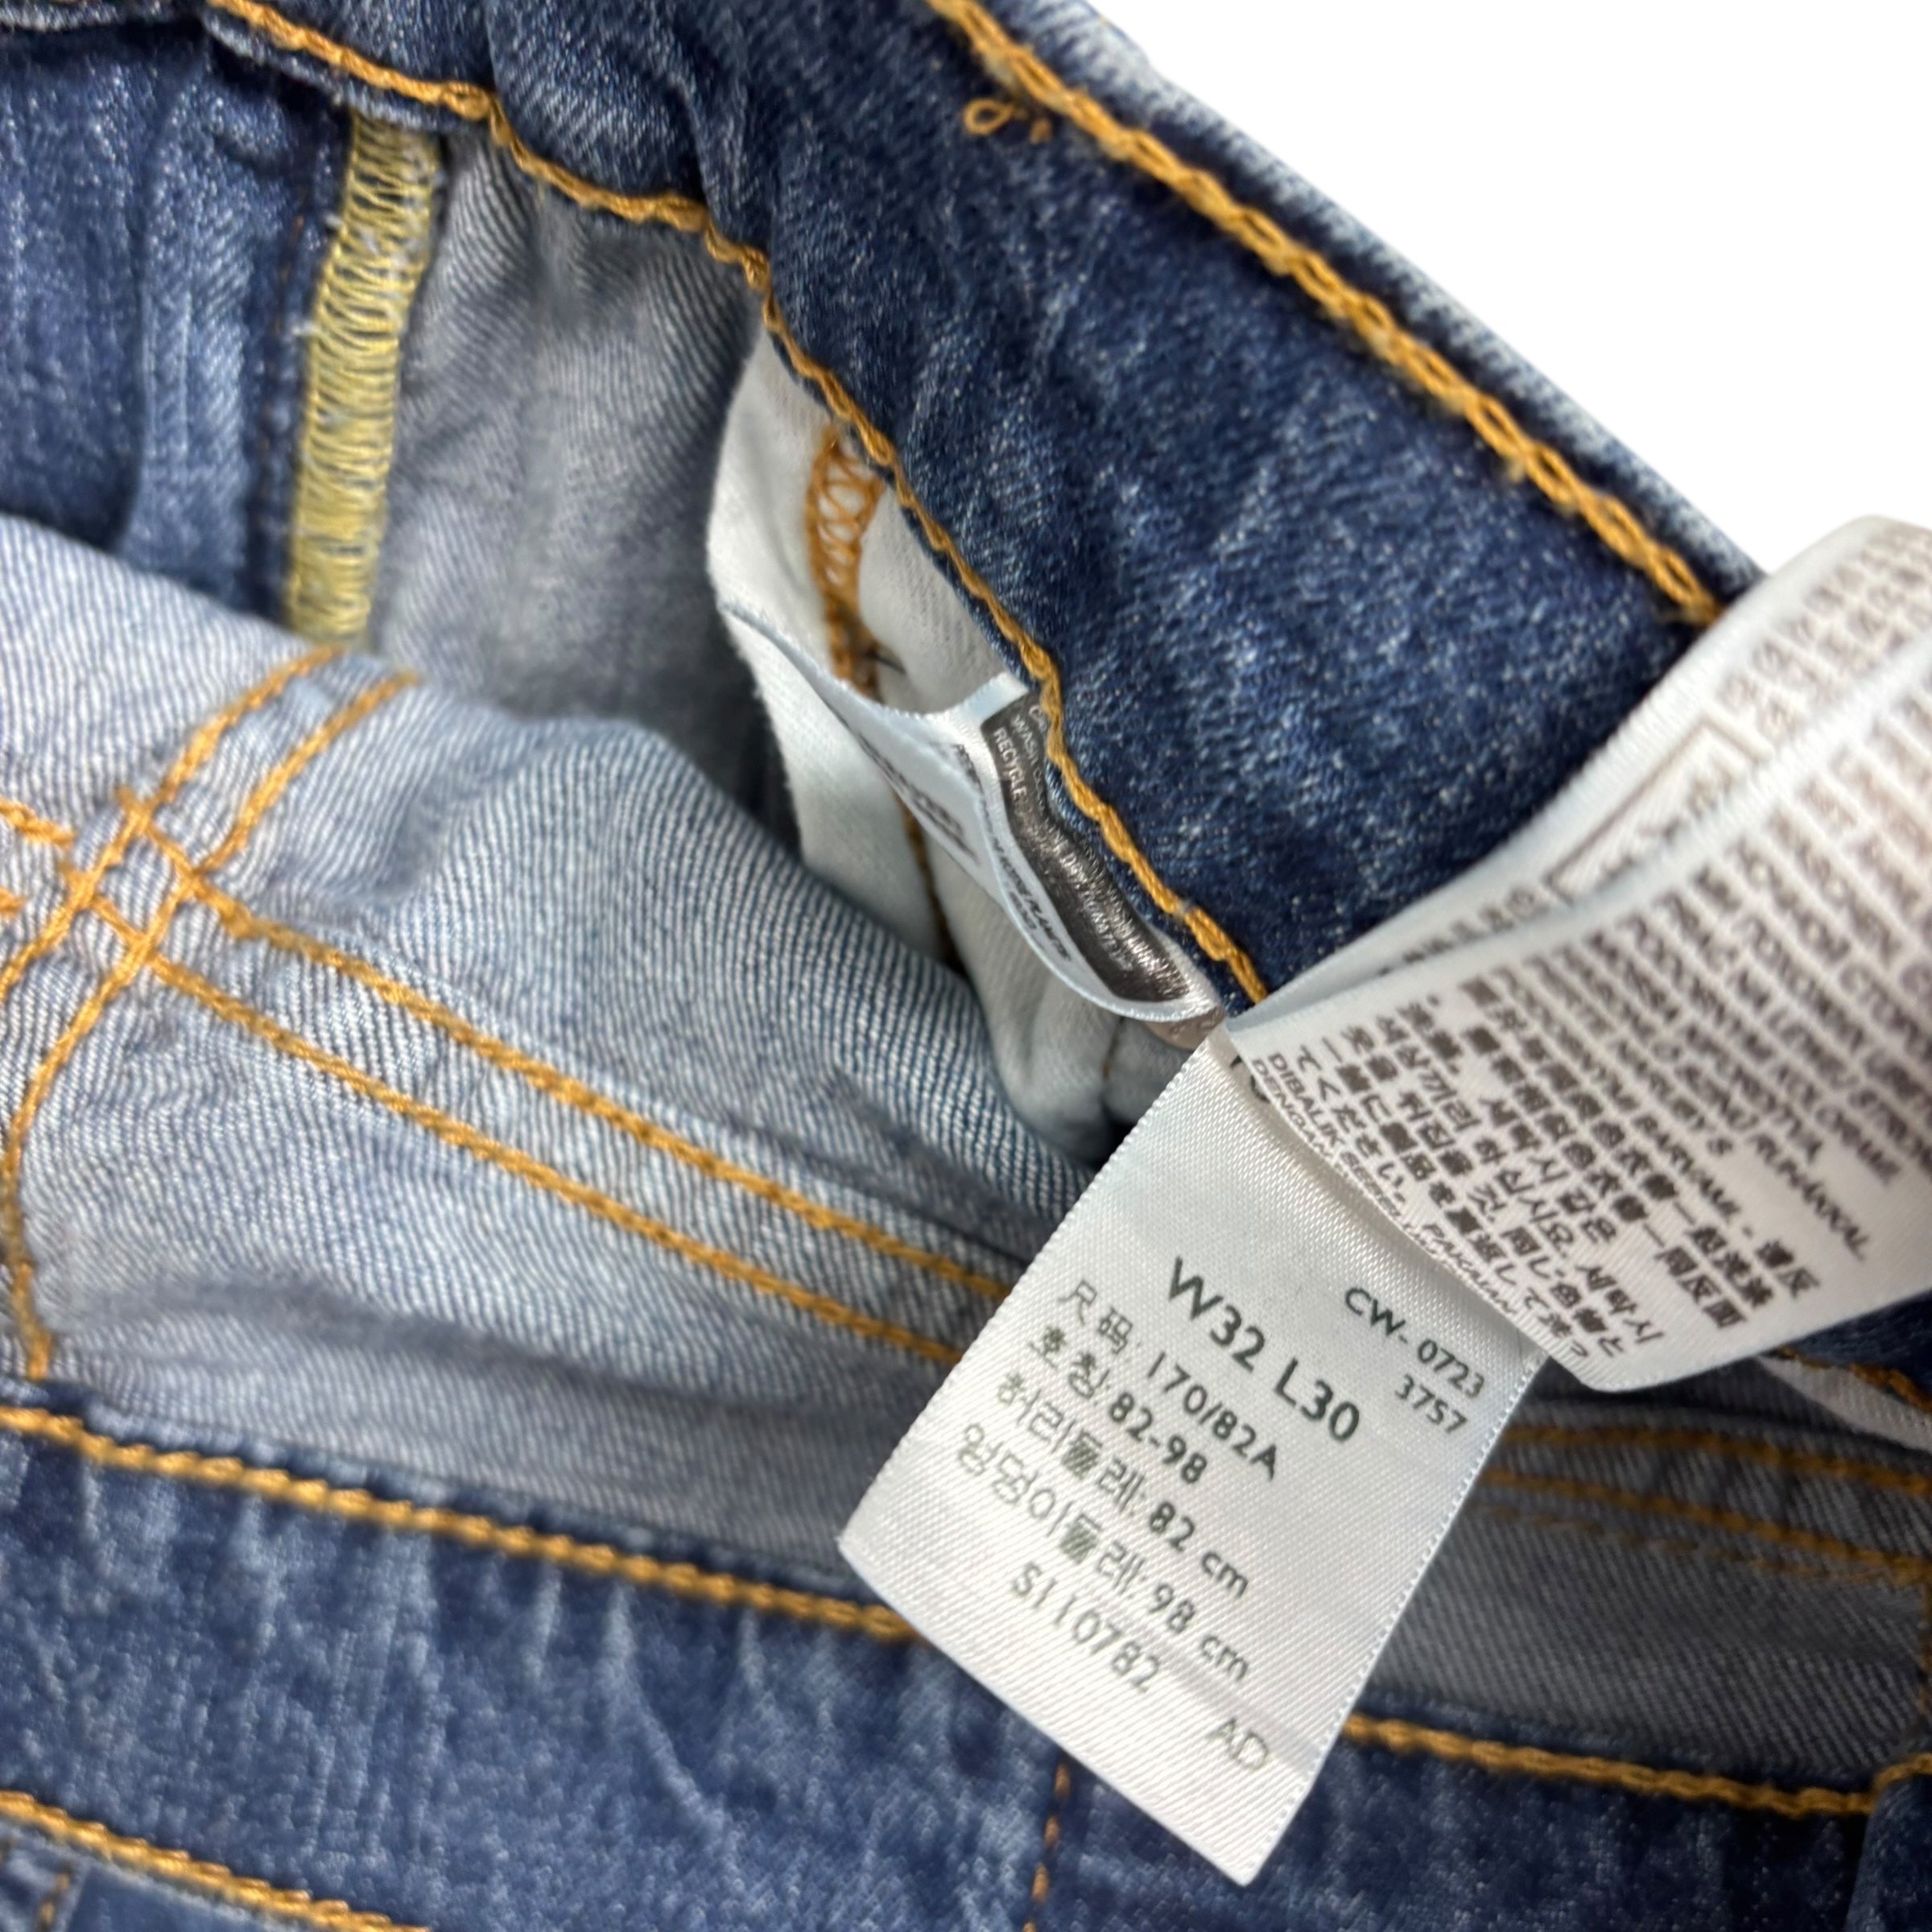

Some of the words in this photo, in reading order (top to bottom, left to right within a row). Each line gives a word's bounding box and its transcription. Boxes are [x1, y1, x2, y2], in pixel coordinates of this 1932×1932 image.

[1267, 1051, 1344, 1147] DIBALIK
[1168, 1256, 1267, 1373] W32
[1274, 1357, 1361, 1443] L30
[1416, 1338, 1485, 1399] 0723
[1108, 1390, 1209, 1485] 82-98
[1146, 1352, 1278, 1482] 170/82A
[1395, 1373, 1468, 1435] 3757
[1147, 1500, 1196, 1554] 82
[1199, 1550, 1249, 1599] cm
[1148, 1583, 1198, 1635] 98
[1199, 1633, 1250, 1683] cm
[1205, 1711, 1279, 1772] AD
